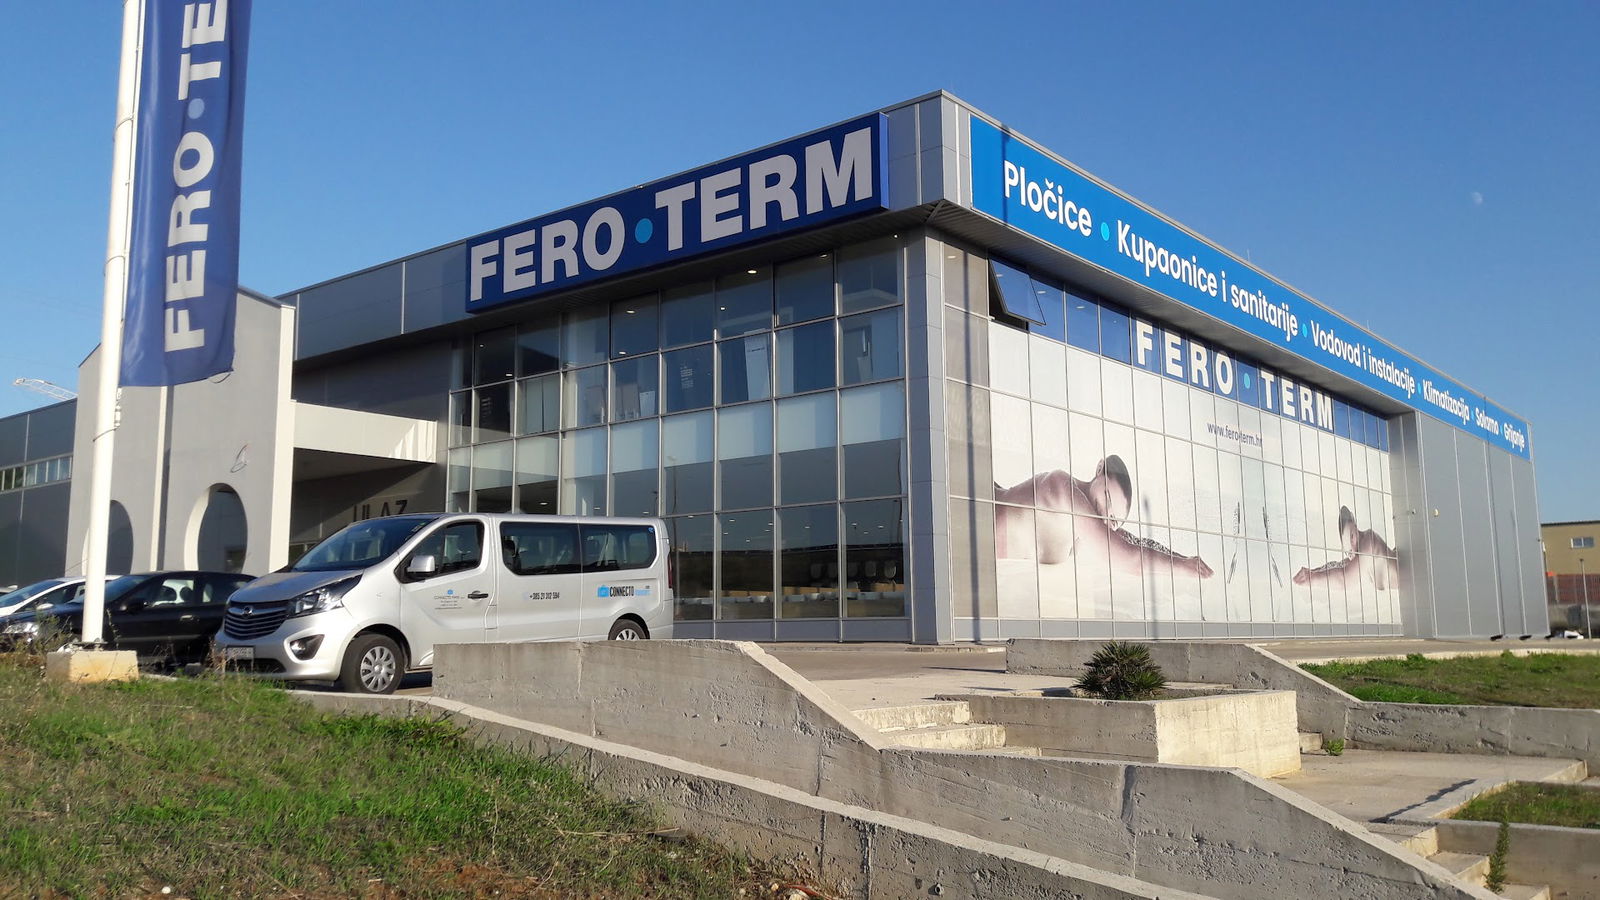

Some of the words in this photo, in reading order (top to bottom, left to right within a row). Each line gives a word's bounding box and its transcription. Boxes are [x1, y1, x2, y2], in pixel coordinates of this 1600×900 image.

[163, 131, 215, 352] FERO
[470, 207, 625, 302] FERO
[655, 126, 873, 252] TERM
[1003, 160, 1092, 237] Pločice
[1117, 220, 1218, 297] Kupaonice
[1221, 271, 1227, 302] i
[1231, 284, 1298, 342] sanitarije
[1311, 320, 1361, 367] Vodovod
[1362, 345, 1367, 370] i
[1368, 347, 1415, 399] instalacije
[1422, 379, 1470, 425] Klimatizacija
[1135, 320, 1234, 395] FERO
[1260, 370, 1334, 431] TERM
[610, 585, 634, 597] CONNECTO
